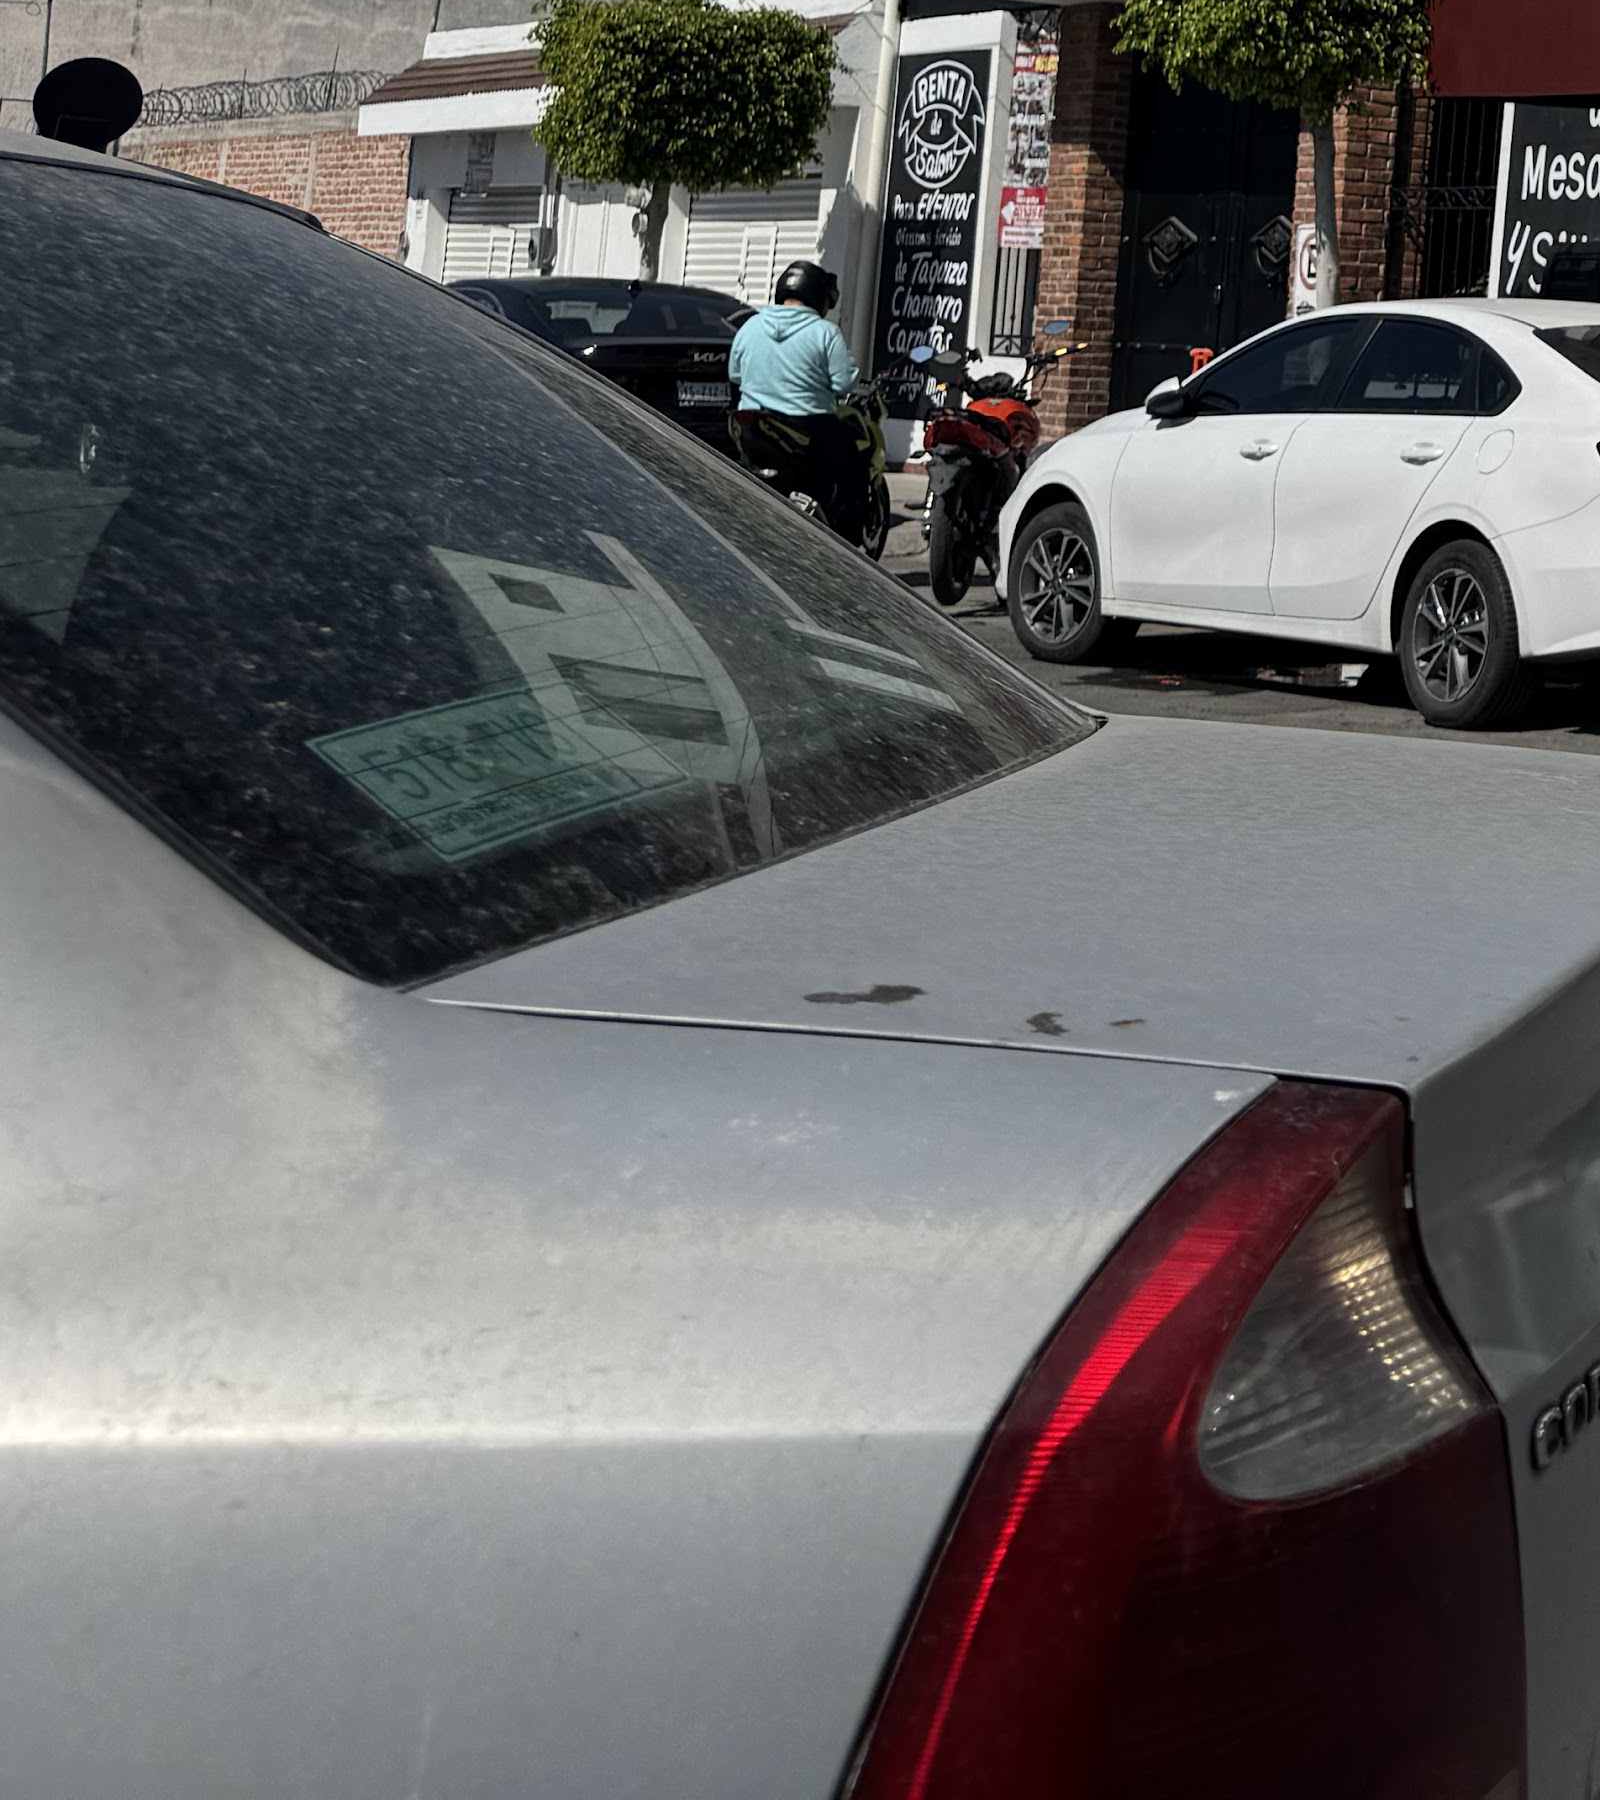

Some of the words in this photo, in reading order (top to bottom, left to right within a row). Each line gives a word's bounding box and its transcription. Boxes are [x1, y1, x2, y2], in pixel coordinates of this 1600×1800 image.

[917, 69, 967, 109] RENTA
[930, 111, 943, 136] de
[891, 285, 963, 324] Chamorro
